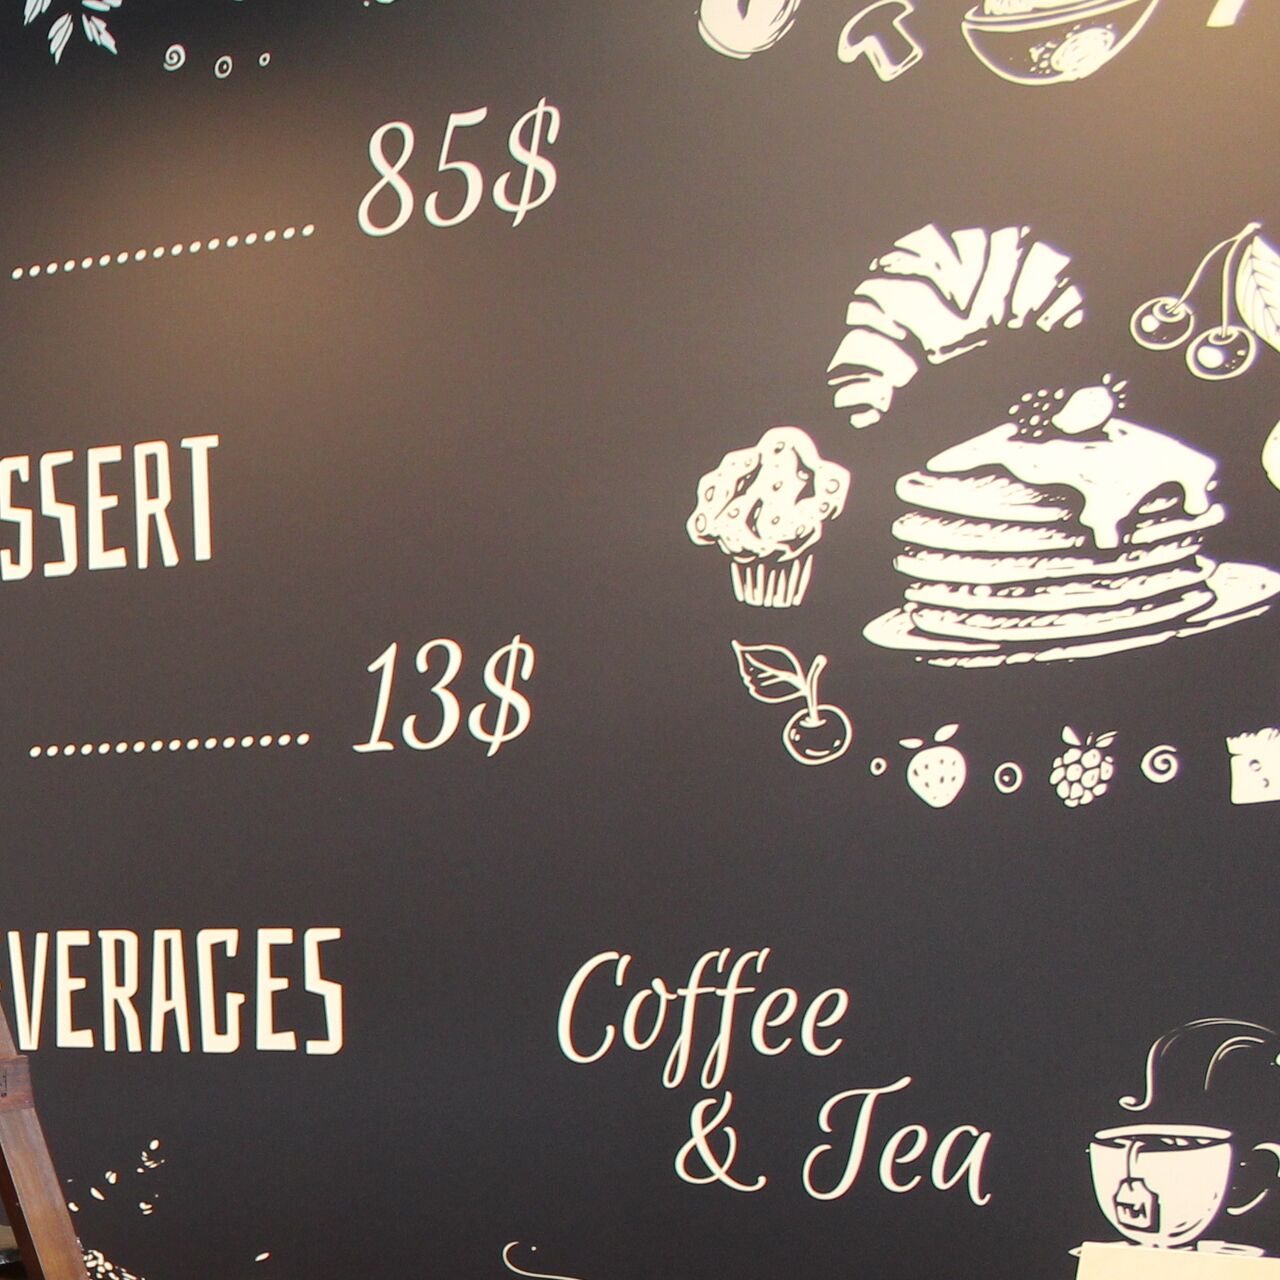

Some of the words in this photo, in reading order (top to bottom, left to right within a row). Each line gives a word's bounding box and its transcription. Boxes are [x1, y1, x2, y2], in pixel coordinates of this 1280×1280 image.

[357, 97, 561, 237] 85$
[352, 635, 535, 757] 13$
[557, 947, 849, 1090] Coffee
[674, 1091, 766, 1192] &
[802, 1076, 992, 1206] Tea
